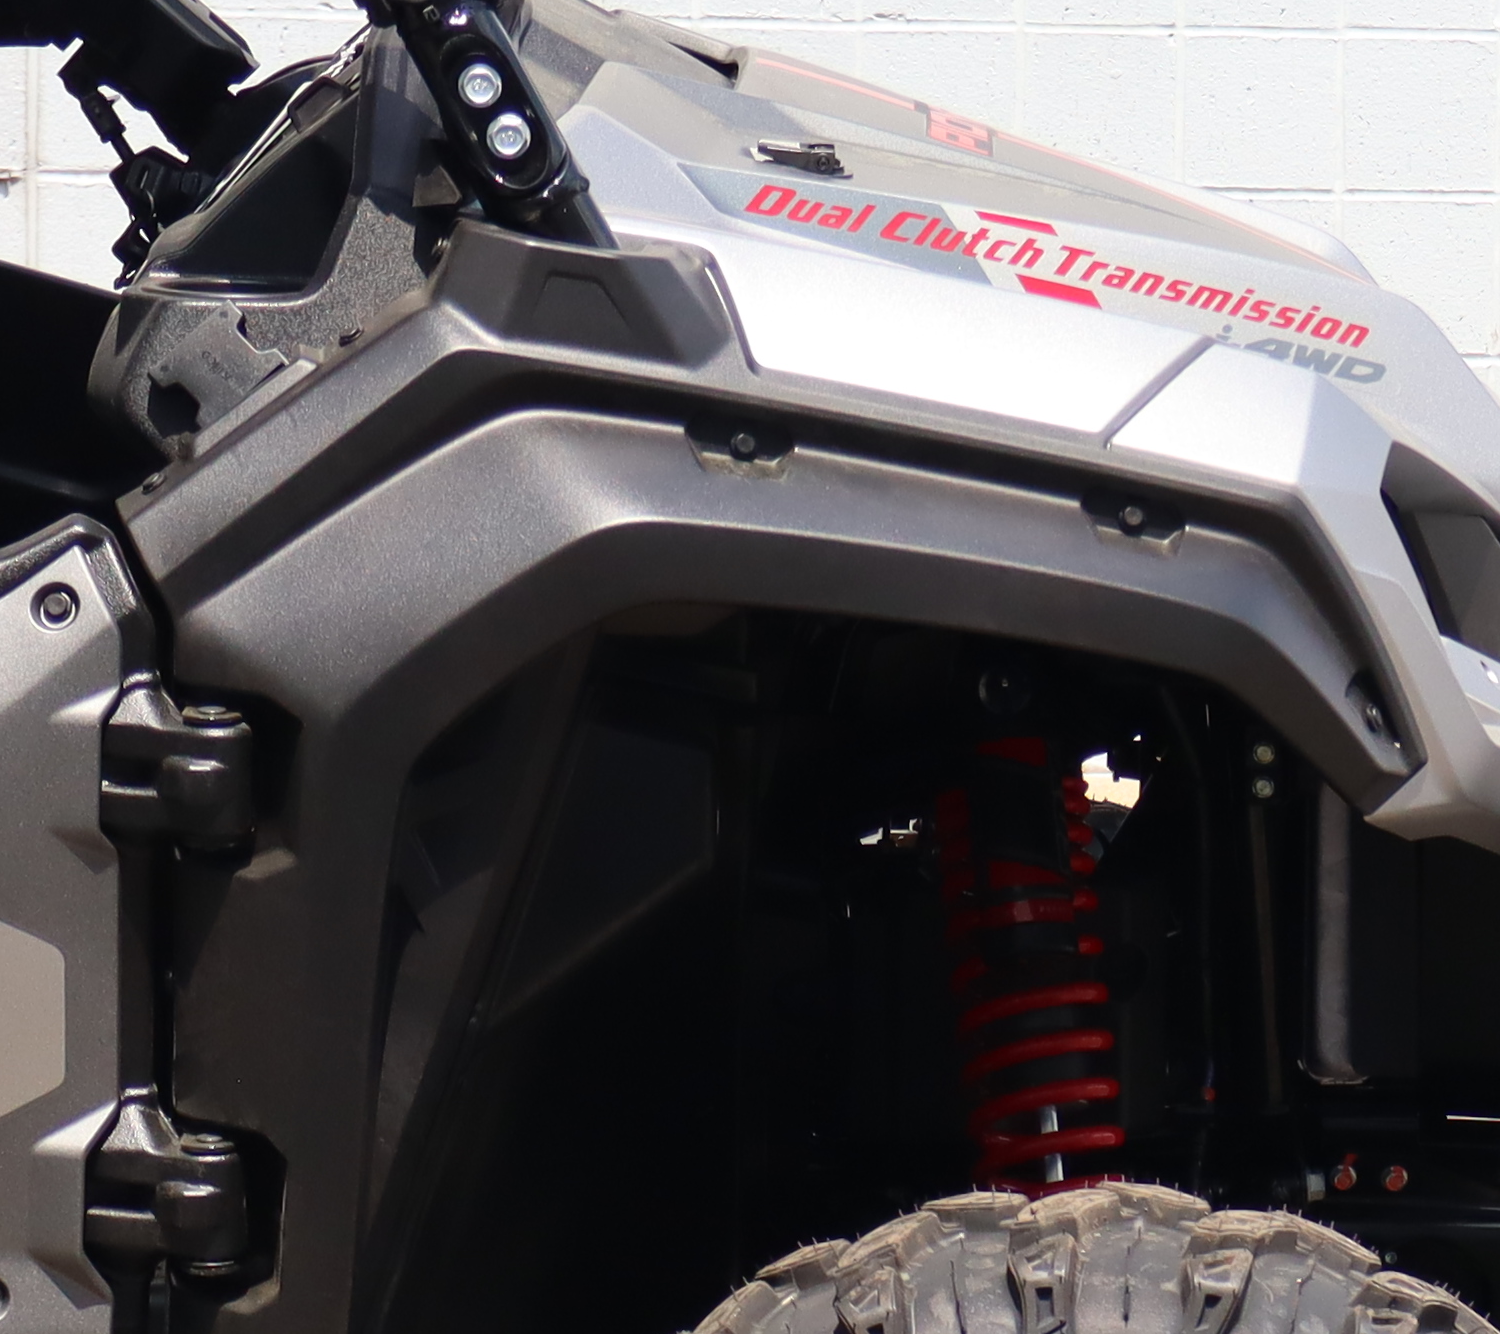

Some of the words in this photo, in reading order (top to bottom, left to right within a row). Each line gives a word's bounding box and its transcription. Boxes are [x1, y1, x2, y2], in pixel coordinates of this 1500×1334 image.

[745, 184, 875, 234] Dual
[880, 210, 1046, 269] Clutch
[1052, 244, 1370, 349] Transmission
